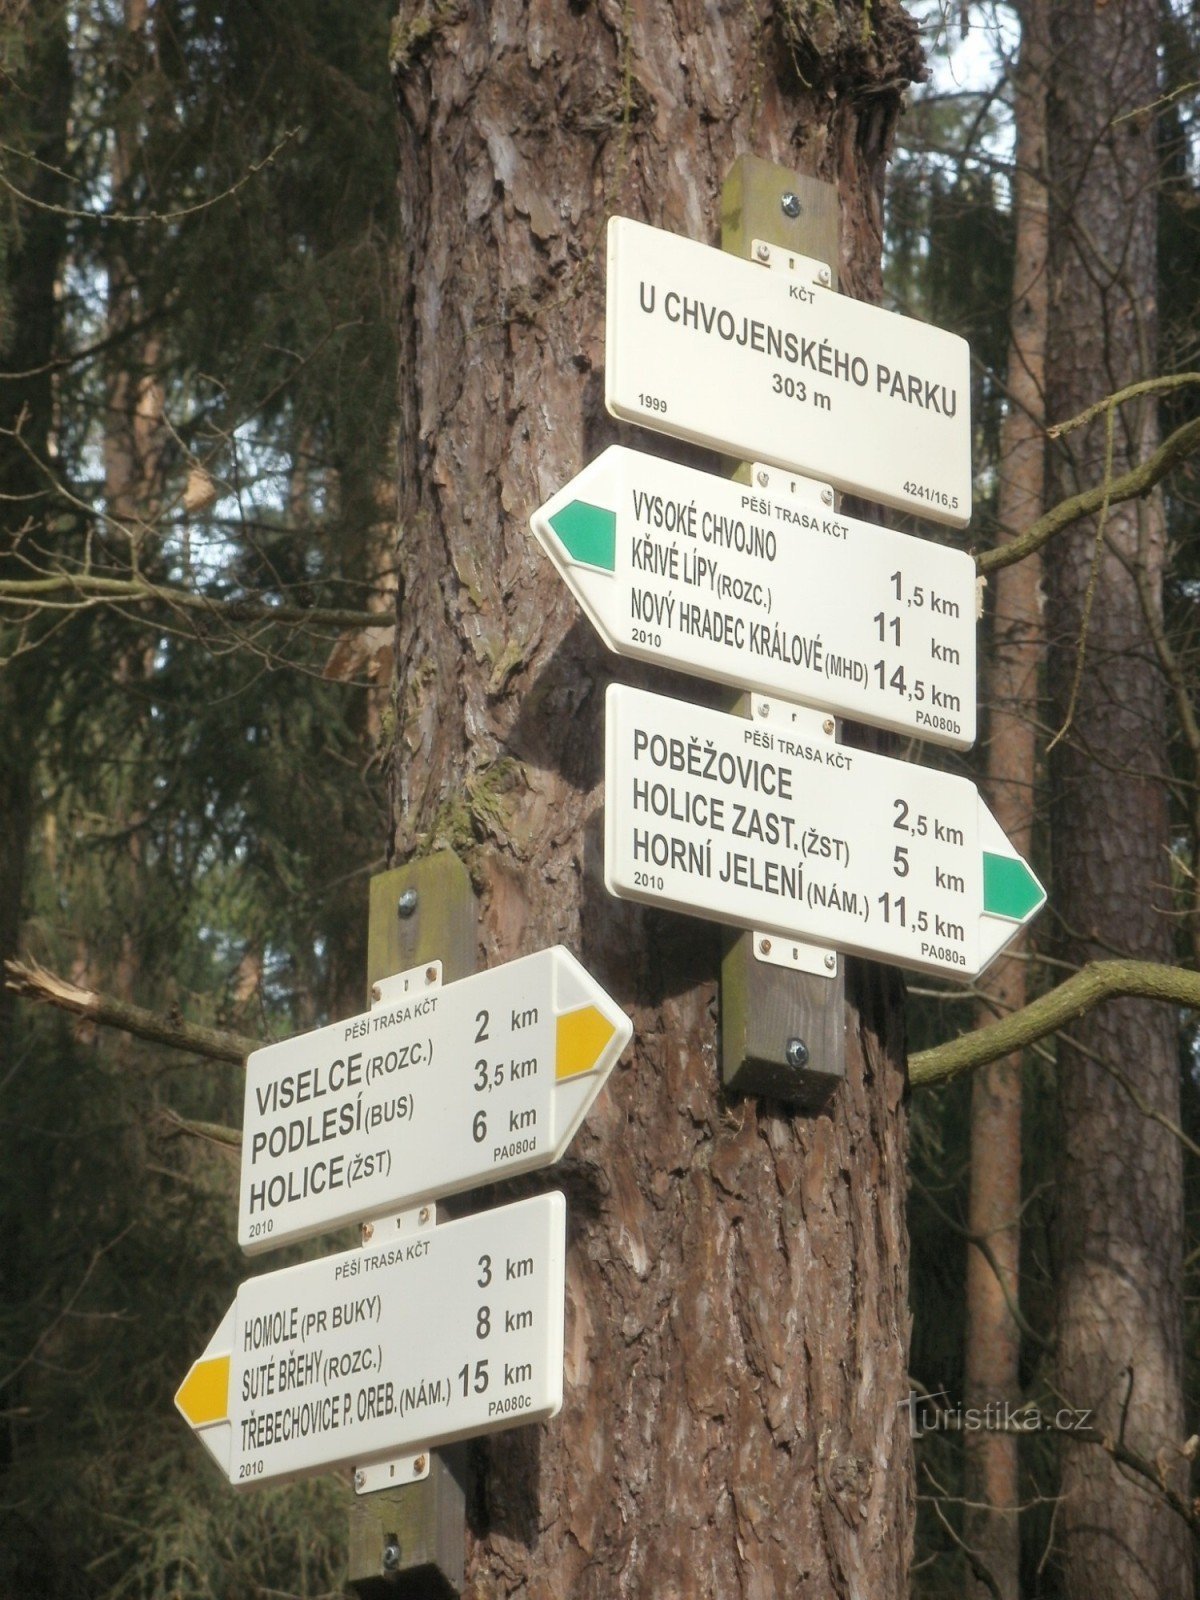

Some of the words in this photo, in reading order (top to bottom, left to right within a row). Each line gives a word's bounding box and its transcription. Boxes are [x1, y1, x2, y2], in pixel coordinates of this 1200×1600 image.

[789, 285, 815, 304] KČT
[639, 282, 655, 313] U
[664, 292, 868, 386] CHVOJENSKÉHO
[877, 364, 956, 418] PARKU
[638, 394, 667, 413] 1999
[772, 373, 807, 402] 303
[814, 392, 831, 411] m
[903, 481, 958, 509] 4241/16,5
[741, 496, 771, 516] PĚŠÍ
[774, 506, 819, 531] TRASA
[822, 520, 849, 540] KČT
[633, 490, 697, 538] VYSOKÉ
[702, 511, 776, 562] CHVOJNO
[890, 571, 924, 608] 1,5
[931, 591, 959, 618] km
[632, 533, 678, 580] KŘIVÉ
[874, 612, 901, 647] 11
[931, 638, 959, 665] km
[632, 629, 661, 648] 2010
[632, 588, 675, 629] NOVÝ
[680, 602, 744, 649] HRADEC
[874, 659, 925, 702] 14,5
[931, 685, 961, 712] km
[916, 711, 961, 734] PA080b
[744, 731, 774, 750] PĚŠÍ
[778, 739, 823, 763] TRASA
[826, 752, 852, 771] KČT
[634, 729, 792, 800] POBĚŽOVICE
[893, 799, 928, 836] 2,5
[934, 819, 963, 846] km
[633, 778, 724, 831] HOLICE
[894, 846, 909, 878] 5
[935, 867, 964, 893] km
[633, 828, 711, 878] HORNÍ
[878, 892, 928, 933] 11,5
[935, 914, 964, 942] km
[634, 872, 664, 890] 2010
[921, 942, 966, 966] PA080a
[345, 1021, 370, 1042] PĚŠÍ
[372, 1009, 411, 1031] TRASA
[414, 998, 437, 1019] KČT
[475, 1010, 489, 1043] 2
[511, 1007, 538, 1031] km
[474, 1059, 504, 1092] 3,5
[511, 1057, 538, 1081] km
[472, 1110, 487, 1143] 6
[509, 1108, 537, 1132] km
[493, 1137, 536, 1162] PA080d
[249, 1219, 273, 1238] 2010
[335, 1256, 361, 1281] PĚŠÍ
[364, 1250, 403, 1273] TRASA
[406, 1241, 430, 1259] KČT
[332, 1295, 381, 1330] BUKY)
[477, 1255, 492, 1288] 3
[506, 1257, 533, 1280] km
[242, 1356, 275, 1401] SUTÉ
[476, 1306, 490, 1339] 8
[505, 1309, 532, 1332] km
[241, 1393, 339, 1451] TŘEBECHOVICE
[458, 1359, 489, 1398] 15
[504, 1362, 532, 1386] km
[488, 1395, 531, 1417] PA080c
[239, 1460, 264, 1478] 2010
